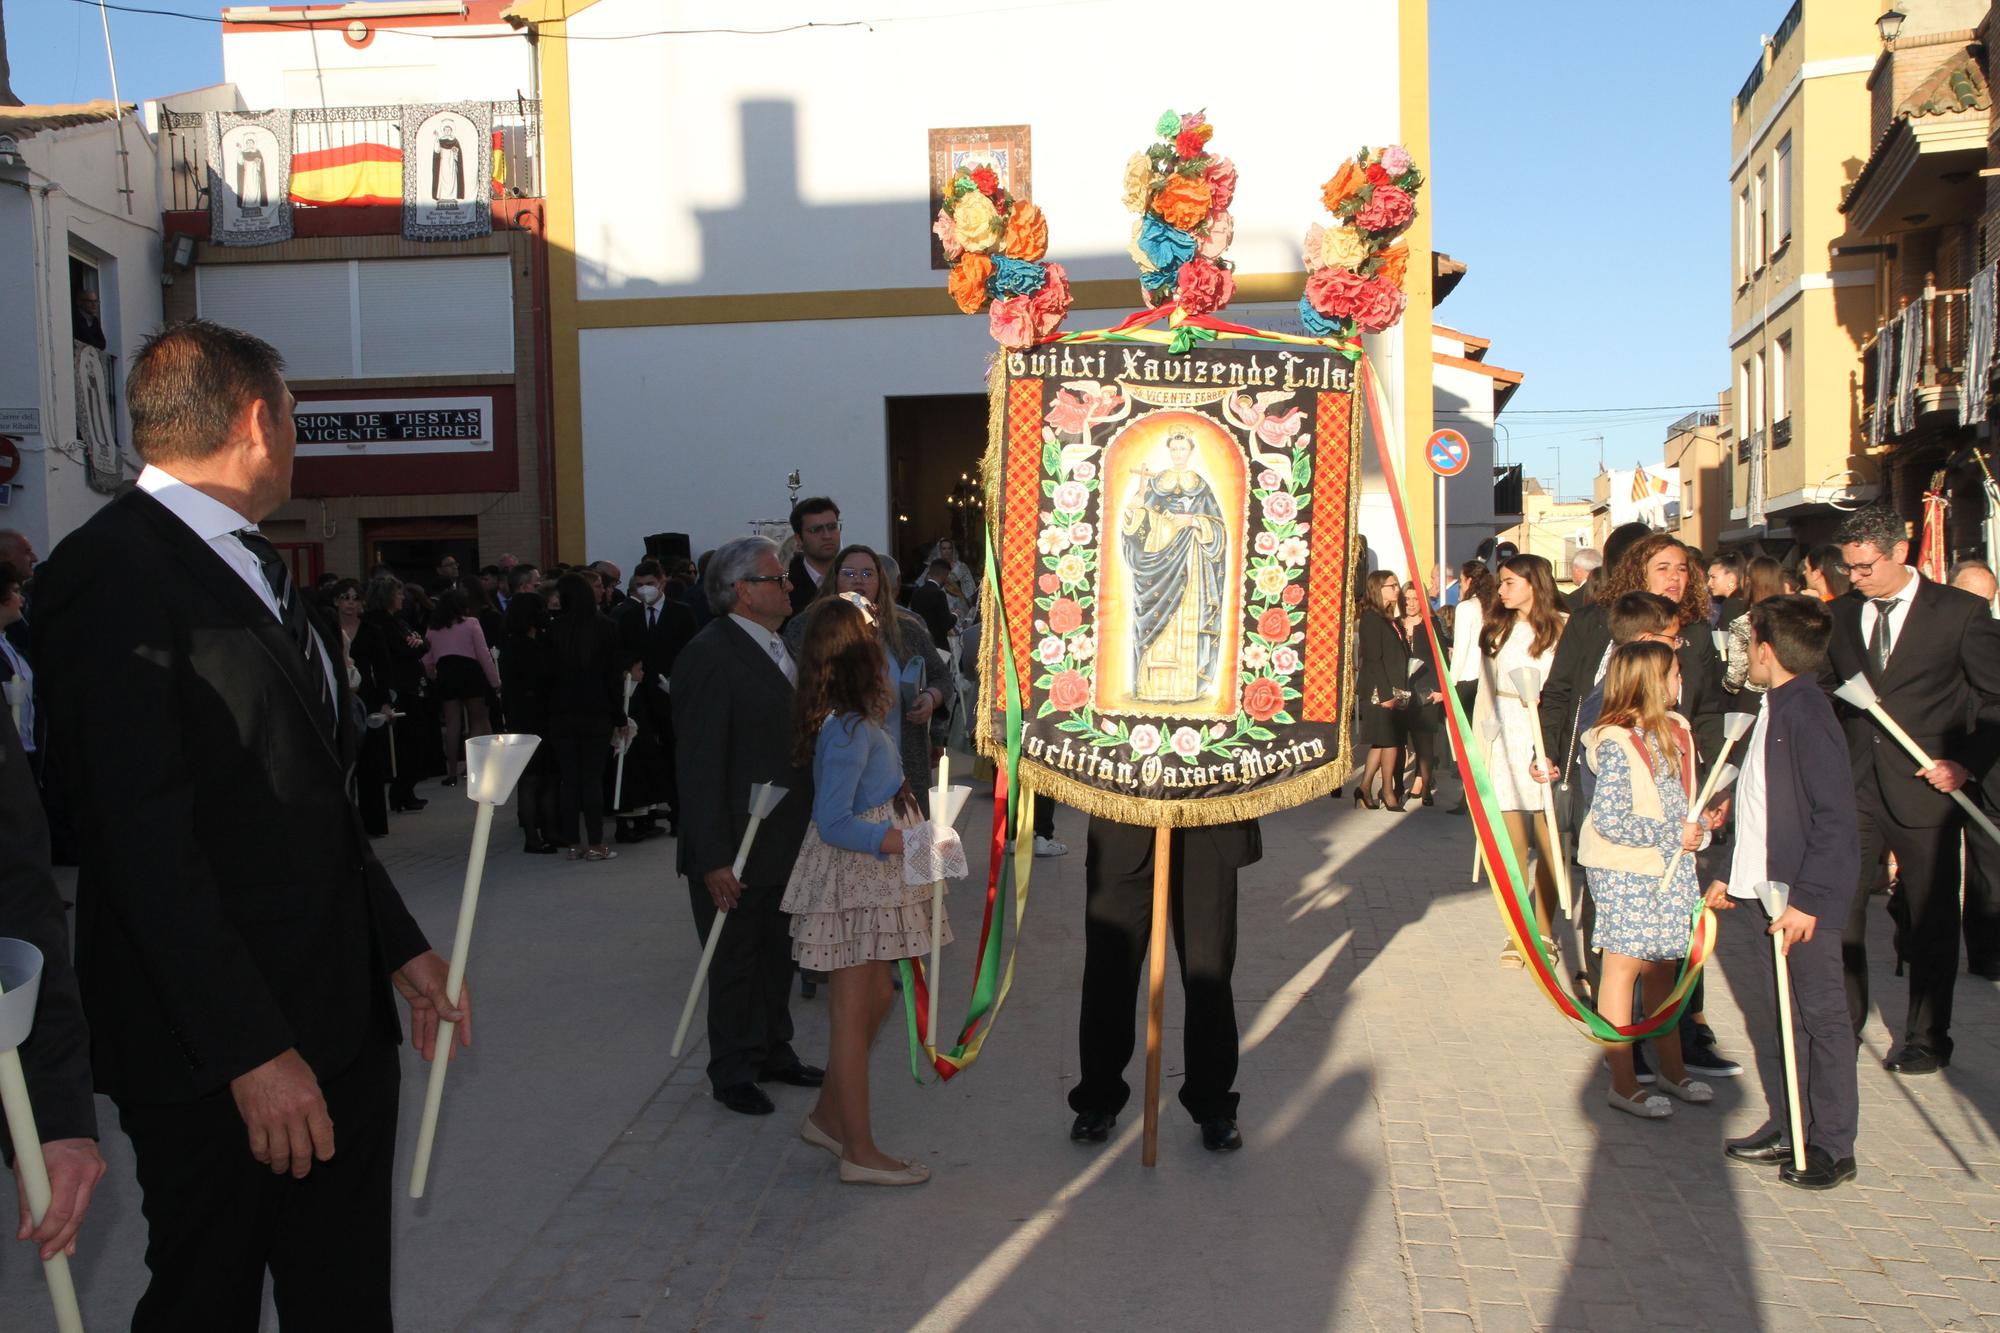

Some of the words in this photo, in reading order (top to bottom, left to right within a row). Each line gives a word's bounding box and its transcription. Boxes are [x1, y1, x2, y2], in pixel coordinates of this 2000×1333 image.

[1117, 348, 1278, 386] Xavizende
[1146, 390, 1192, 404] VICENTE
[1195, 389, 1227, 403] FERRER
[355, 414, 381, 426] DE
[395, 411, 479, 425] FIESTAS
[304, 427, 388, 441] VICENTE
[402, 424, 480, 438] FERRER
